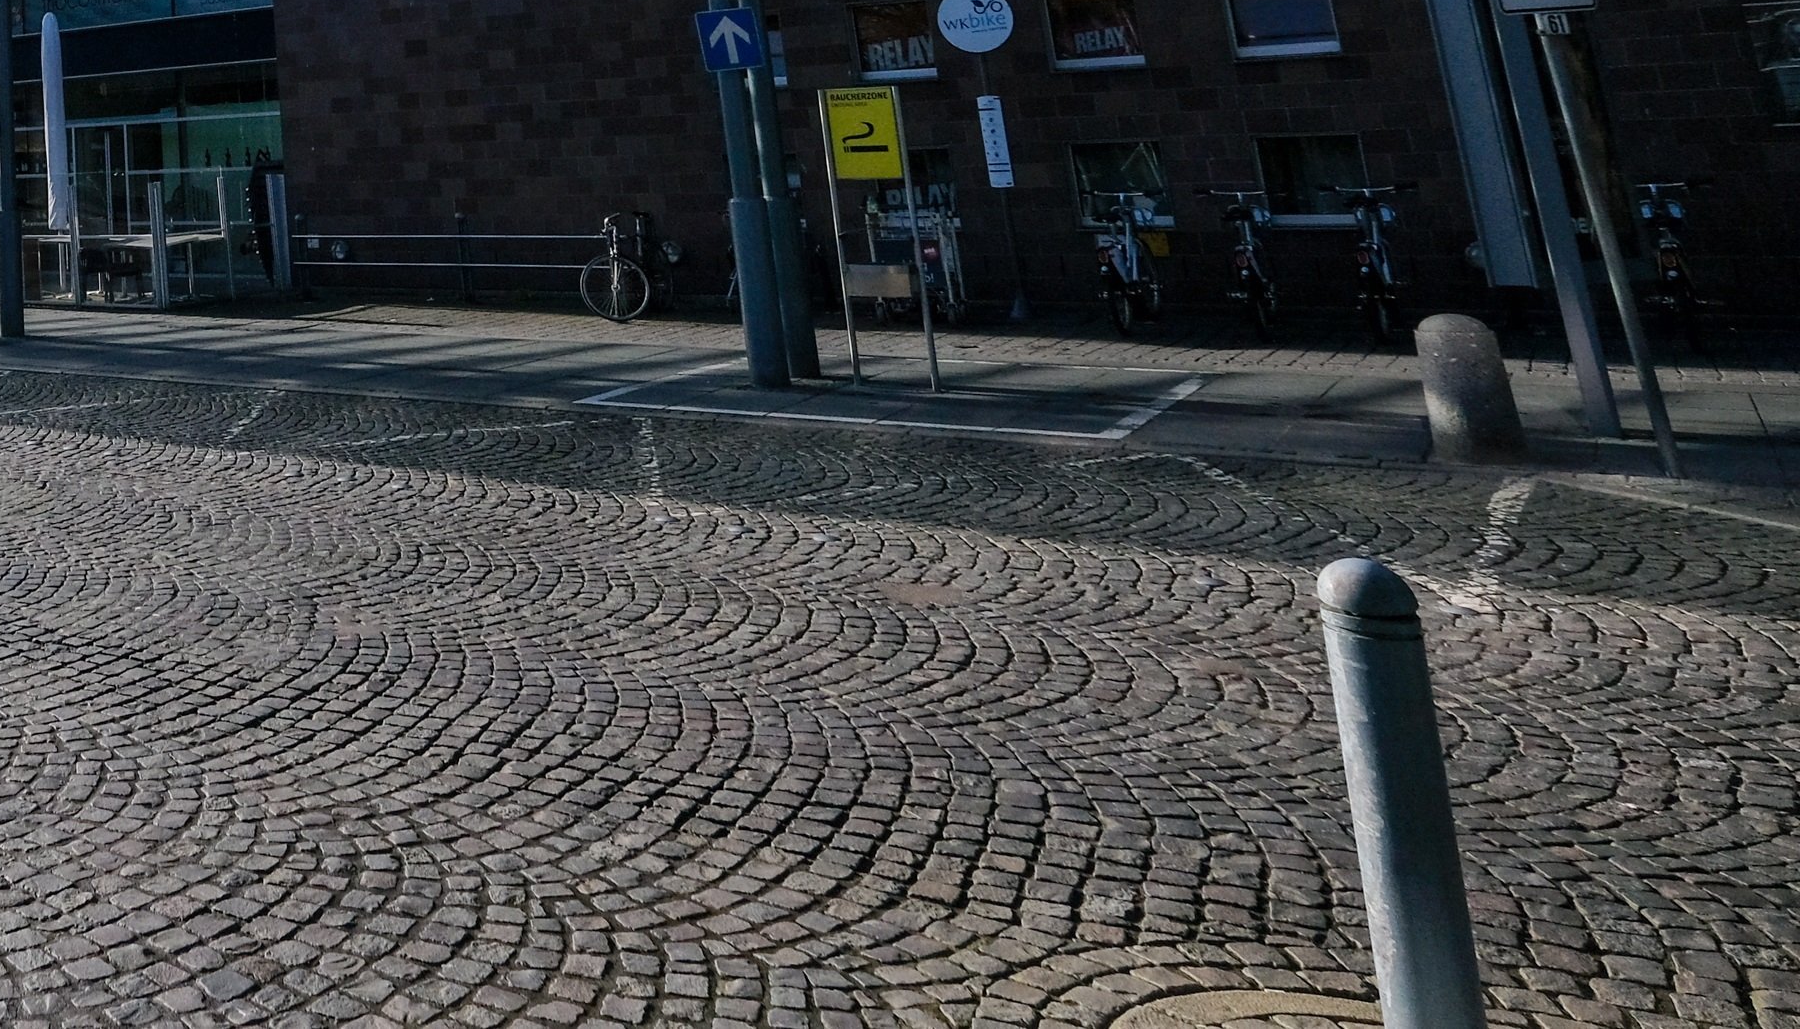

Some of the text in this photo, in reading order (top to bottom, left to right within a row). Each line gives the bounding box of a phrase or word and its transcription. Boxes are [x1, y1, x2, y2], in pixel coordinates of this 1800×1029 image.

[868, 34, 935, 71] RELAY
[1074, 26, 1126, 54] RELAY
[830, 91, 889, 102] RAUCHERZONE
